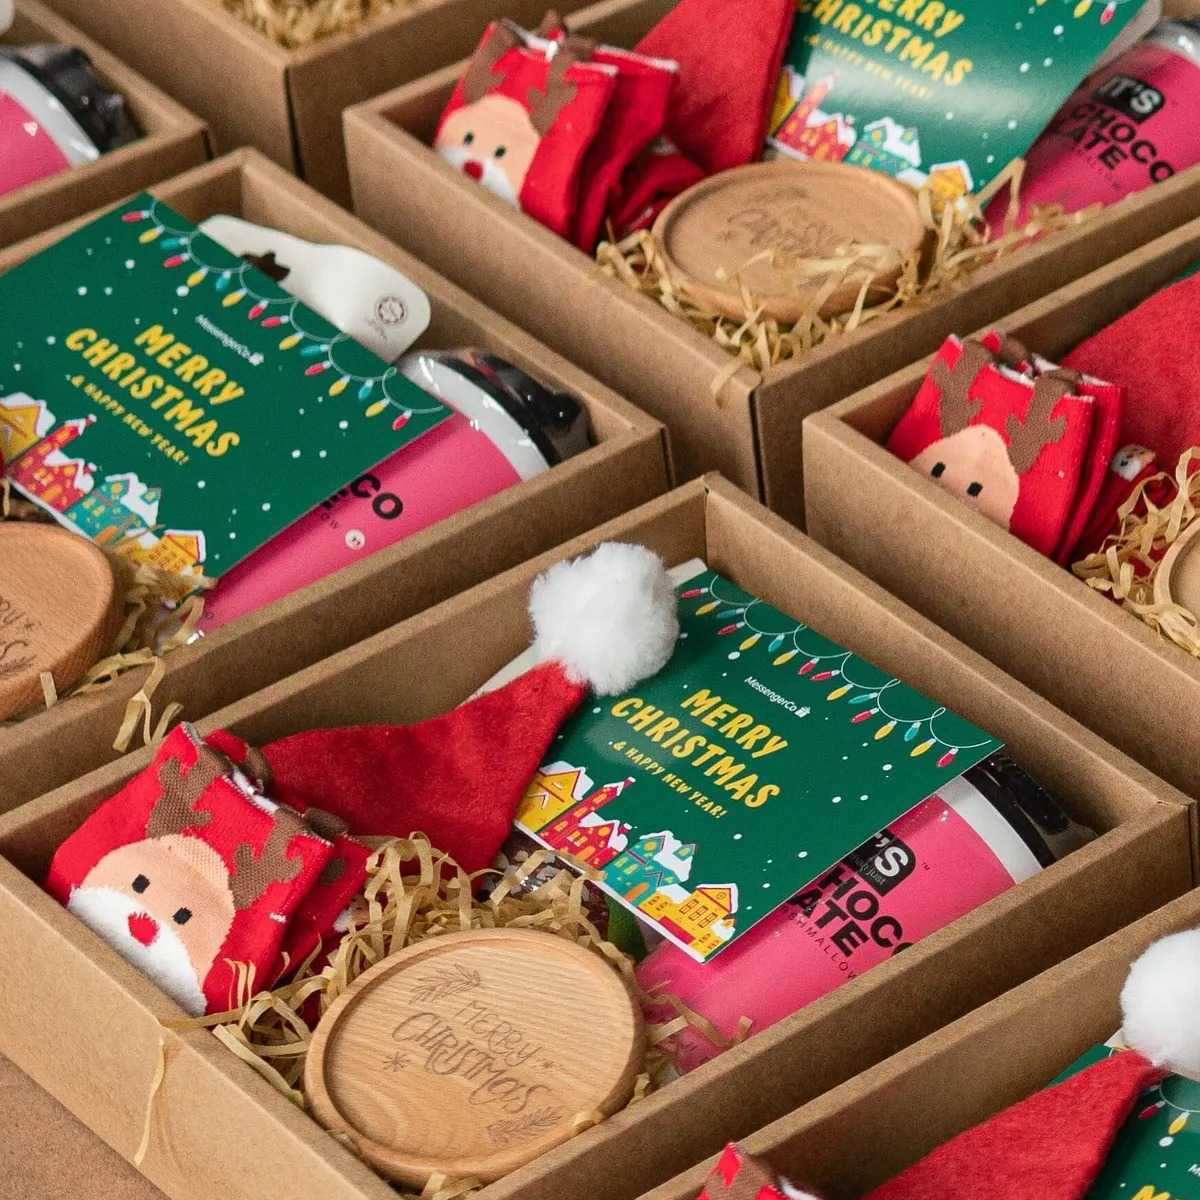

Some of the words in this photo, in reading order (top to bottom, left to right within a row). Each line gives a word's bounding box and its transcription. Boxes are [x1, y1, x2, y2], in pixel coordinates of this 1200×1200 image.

[802, 0, 973, 86] HRISTMAS
[65, 328, 240, 457] CHRISTMAS
[134, 324, 245, 405] MERRY
[680, 688, 788, 759] MERRY
[744, 676, 797, 713] MessengerCo
[611, 697, 780, 808] CHRISTMAS
[624, 746, 666, 776] HAPPY
[662, 773, 692, 794] NEW
[688, 790, 728, 819] YEAR!
[796, 889, 870, 958] ATE
[818, 867, 914, 957] HOC
